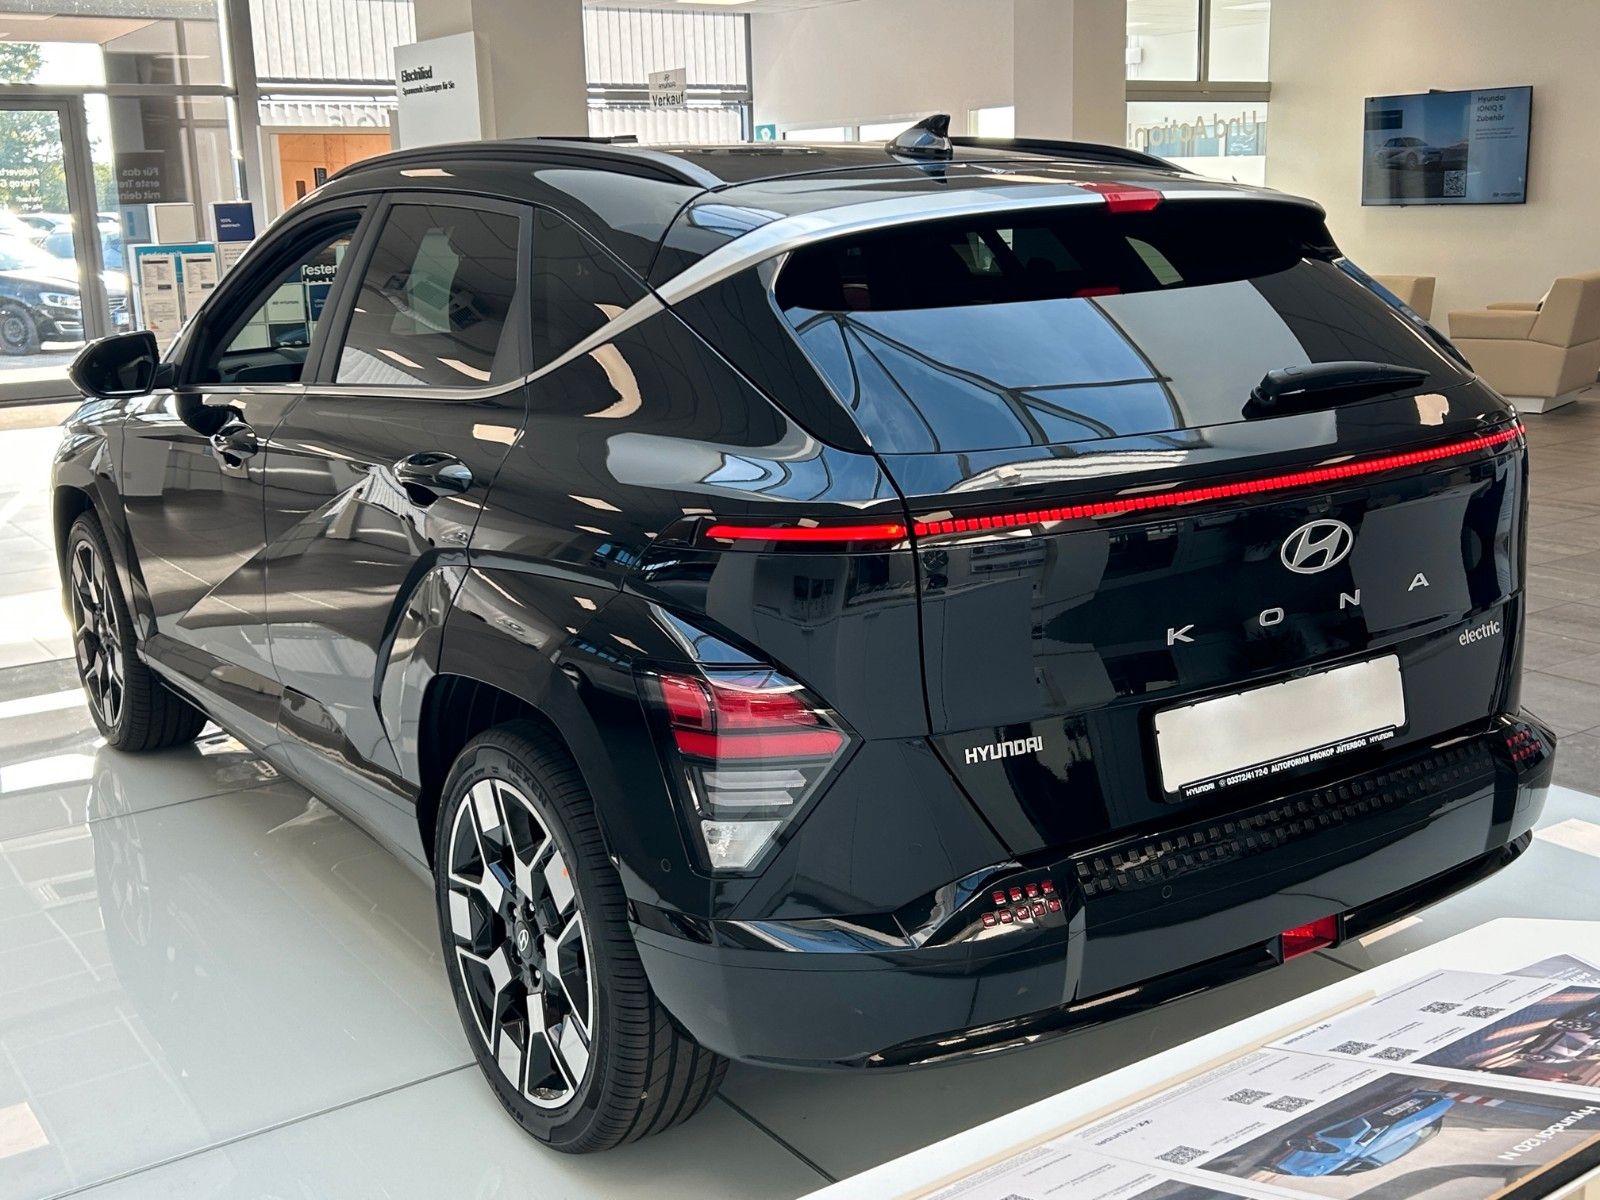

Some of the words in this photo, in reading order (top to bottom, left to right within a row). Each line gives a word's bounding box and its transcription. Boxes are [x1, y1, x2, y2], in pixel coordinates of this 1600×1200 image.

[652, 90, 684, 107] Verkauf
[1167, 572, 1430, 646] KONA
[1458, 620, 1501, 646] electric
[964, 735, 1044, 765] HYUNDAI
[1185, 782, 1216, 797] HYUNDAI
[1270, 755, 1310, 773] AUTOFORUM
[1309, 747, 1335, 762] PROKOP
[1335, 738, 1367, 754] JÜTERBOG
